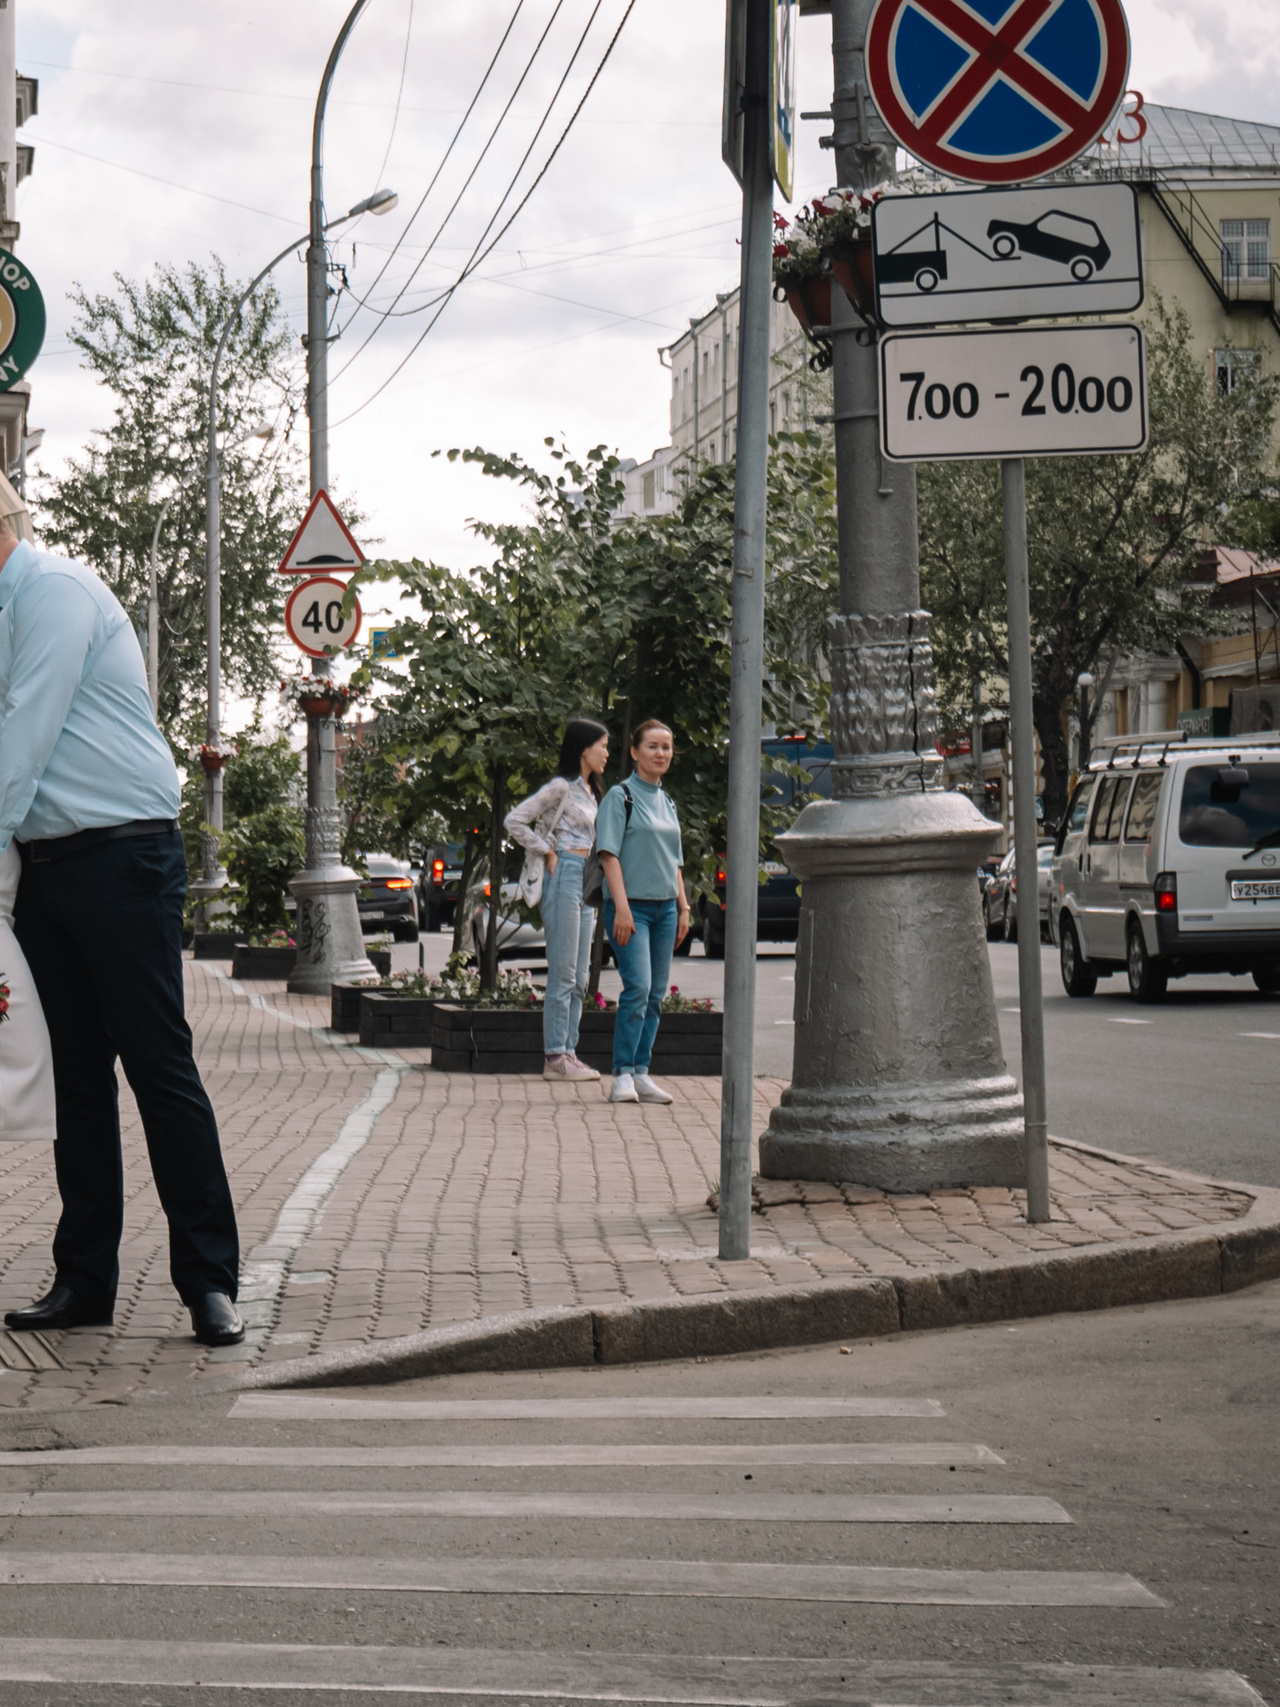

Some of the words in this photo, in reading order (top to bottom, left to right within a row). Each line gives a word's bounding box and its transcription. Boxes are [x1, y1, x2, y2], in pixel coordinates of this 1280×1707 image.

[900, 371, 979, 421] 7.00
[1020, 363, 1133, 416] 20.00
[301, 601, 345, 634] 40
